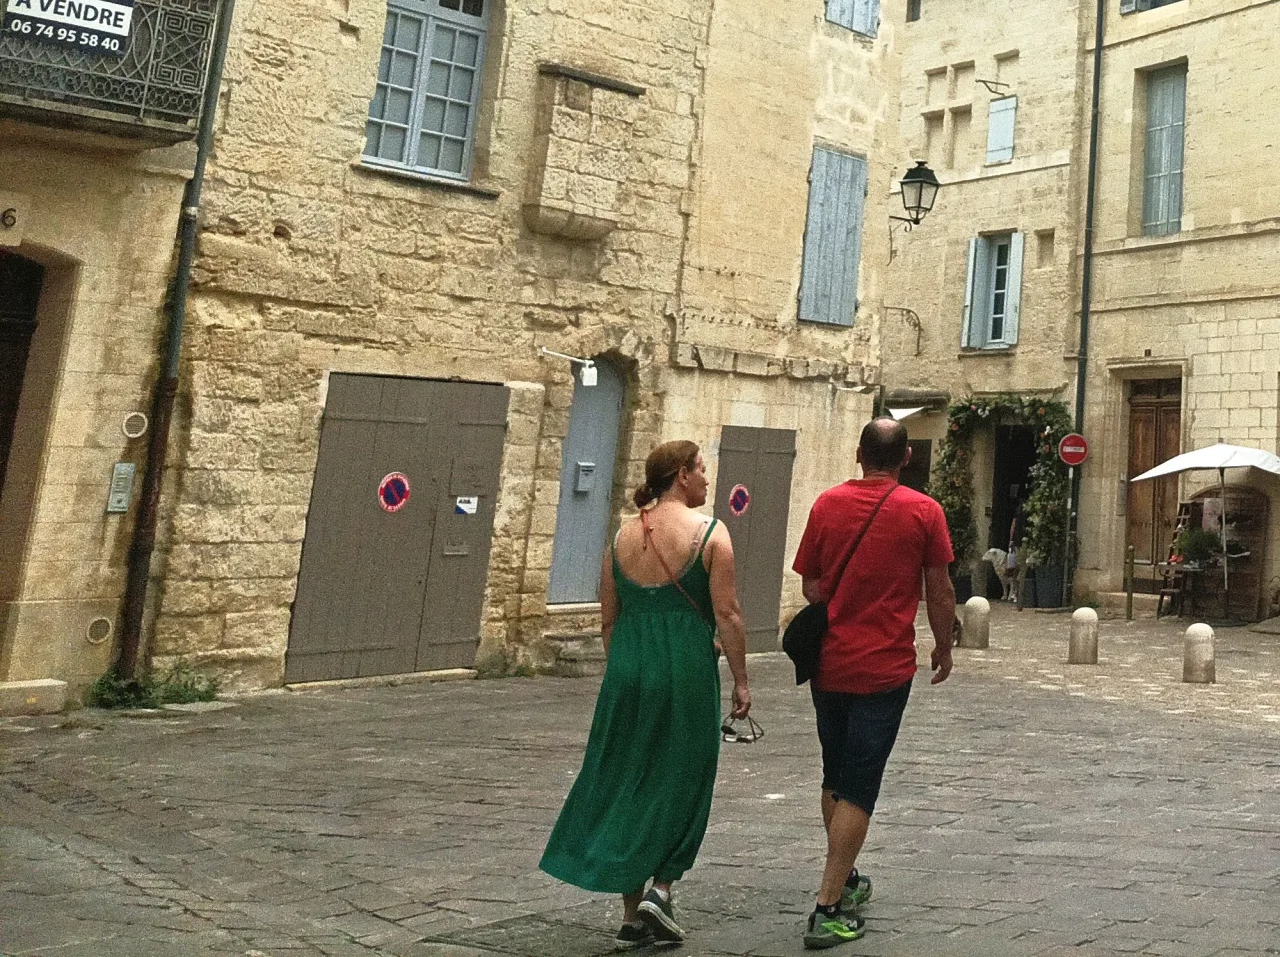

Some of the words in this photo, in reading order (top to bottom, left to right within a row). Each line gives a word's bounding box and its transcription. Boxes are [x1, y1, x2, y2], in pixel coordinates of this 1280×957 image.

[11, 19, 32, 34] 06
[35, 24, 54, 38] 74
[57, 28, 77, 43] 95
[79, 32, 99, 47] 58
[101, 38, 120, 51] 40
